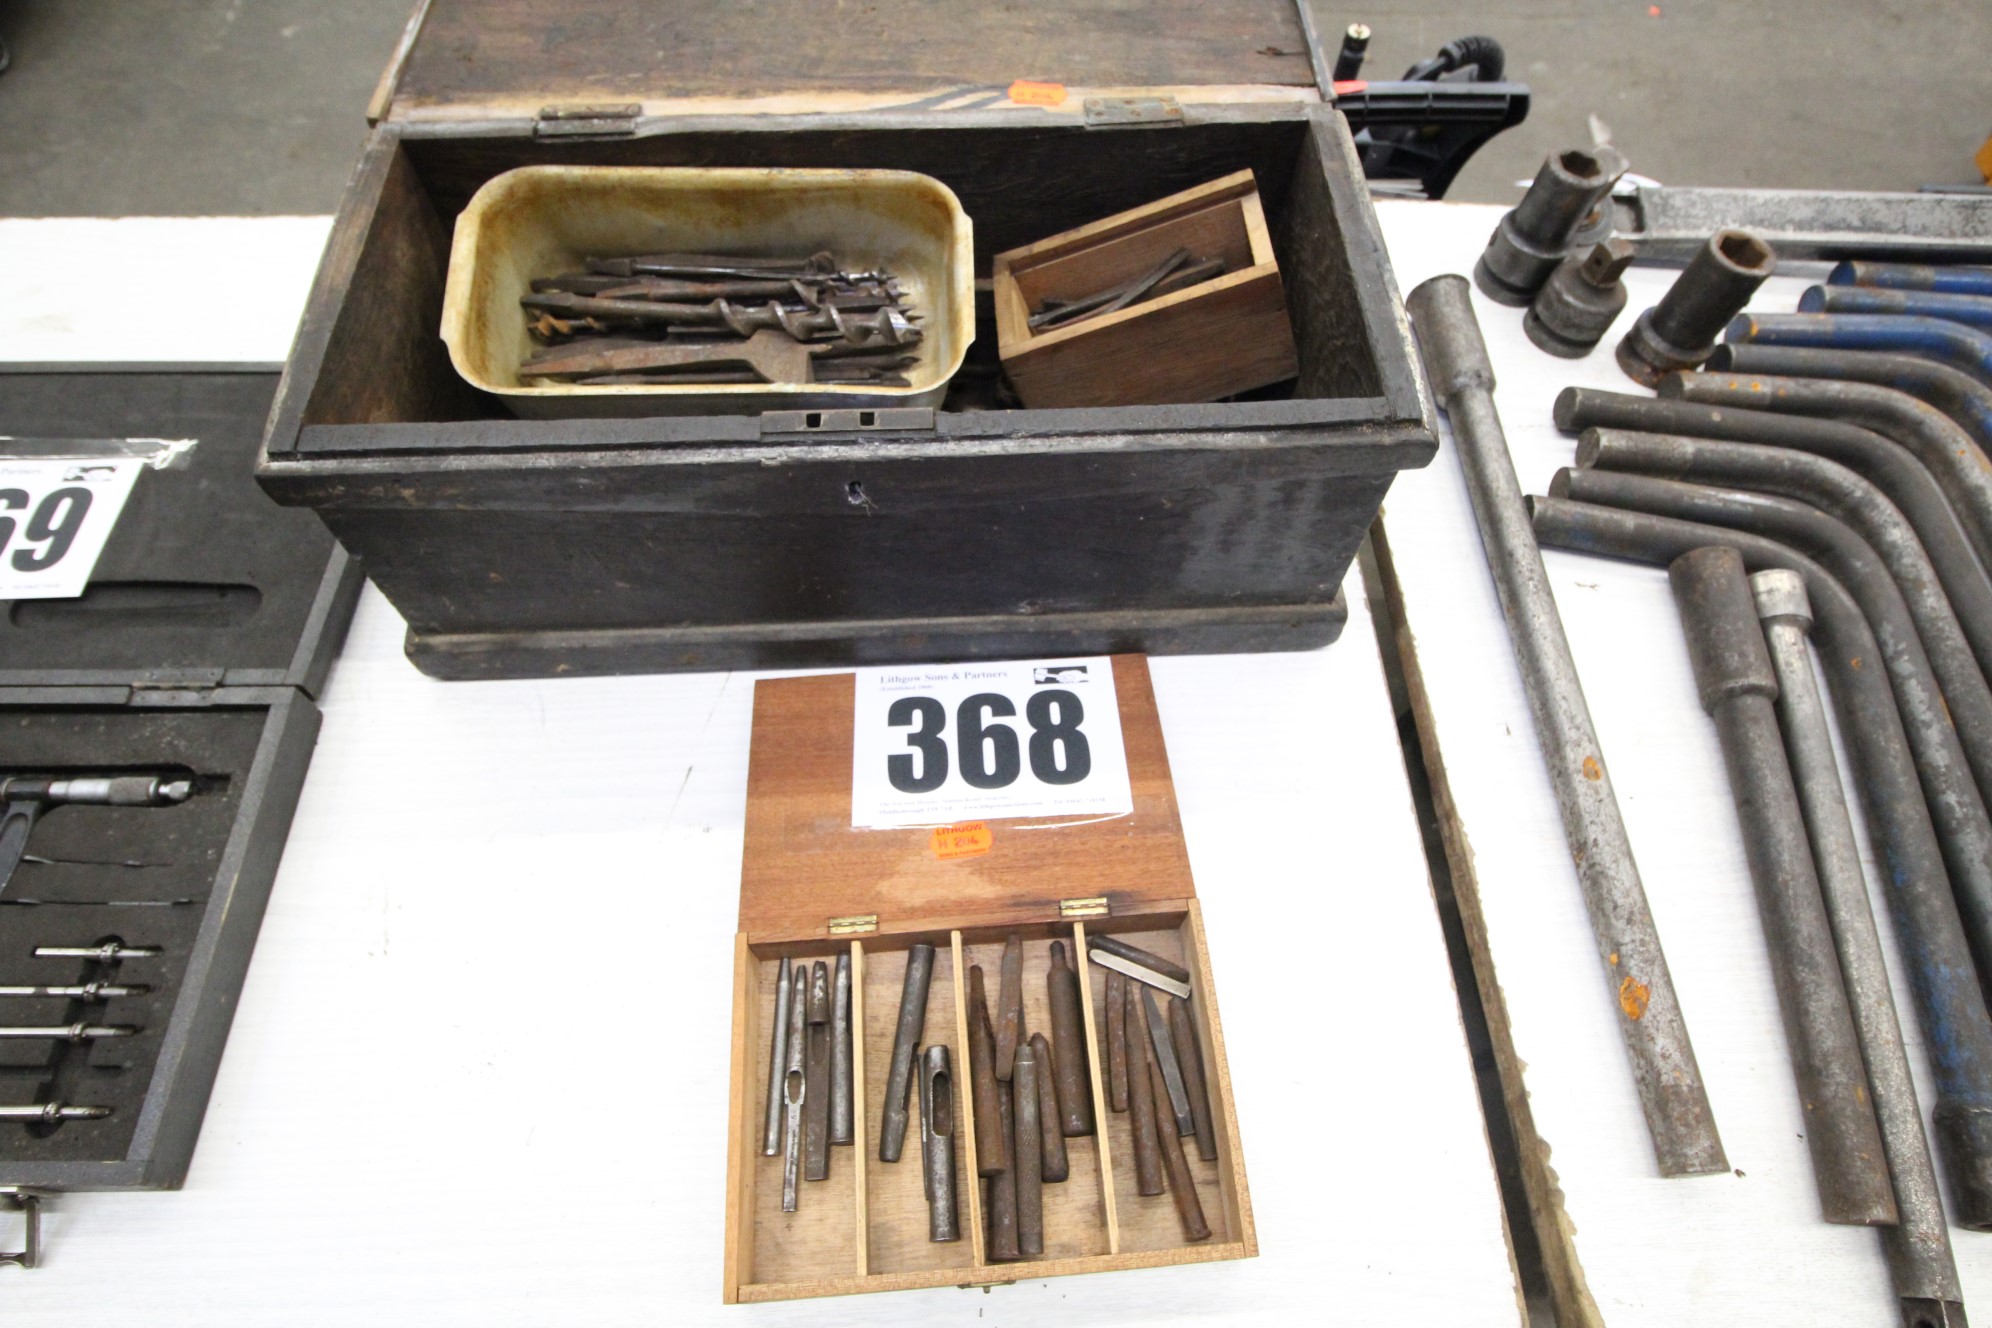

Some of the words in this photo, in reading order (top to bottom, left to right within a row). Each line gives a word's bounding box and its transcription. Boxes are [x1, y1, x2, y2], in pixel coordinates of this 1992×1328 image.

[880, 675, 921, 684] Lithgow
[925, 673, 948, 682] Sons
[951, 672, 960, 680] &
[964, 671, 1008, 679] Partners
[887, 689, 1092, 793] 368
[936, 823, 983, 836] LITHGOW
